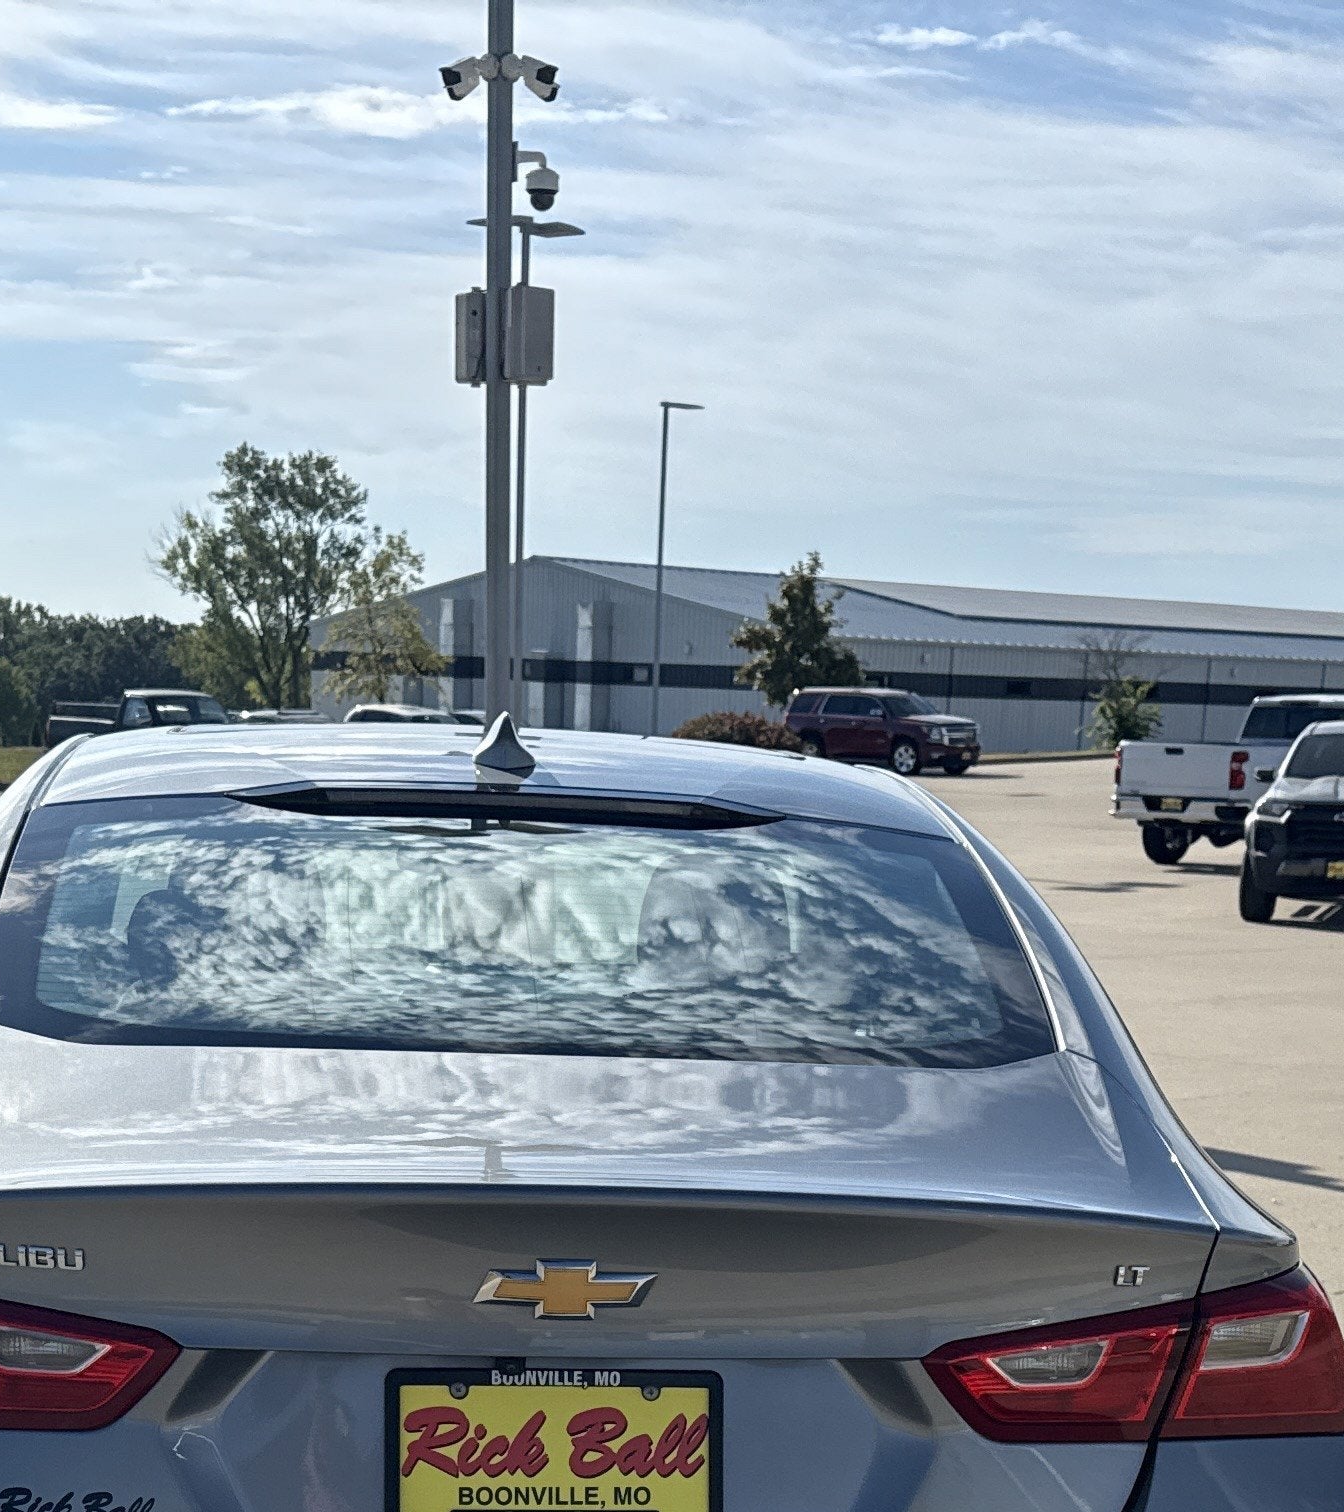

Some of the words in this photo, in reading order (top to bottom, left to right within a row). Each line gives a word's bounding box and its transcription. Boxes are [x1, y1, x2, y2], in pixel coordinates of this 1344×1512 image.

[1114, 1265, 1151, 1287] LT
[594, 1371, 621, 1387] MO
[401, 1405, 549, 1479] Rick
[566, 1406, 709, 1479] Ball
[458, 1486, 607, 1509] BOONVILLE,
[613, 1487, 651, 1506] MO
